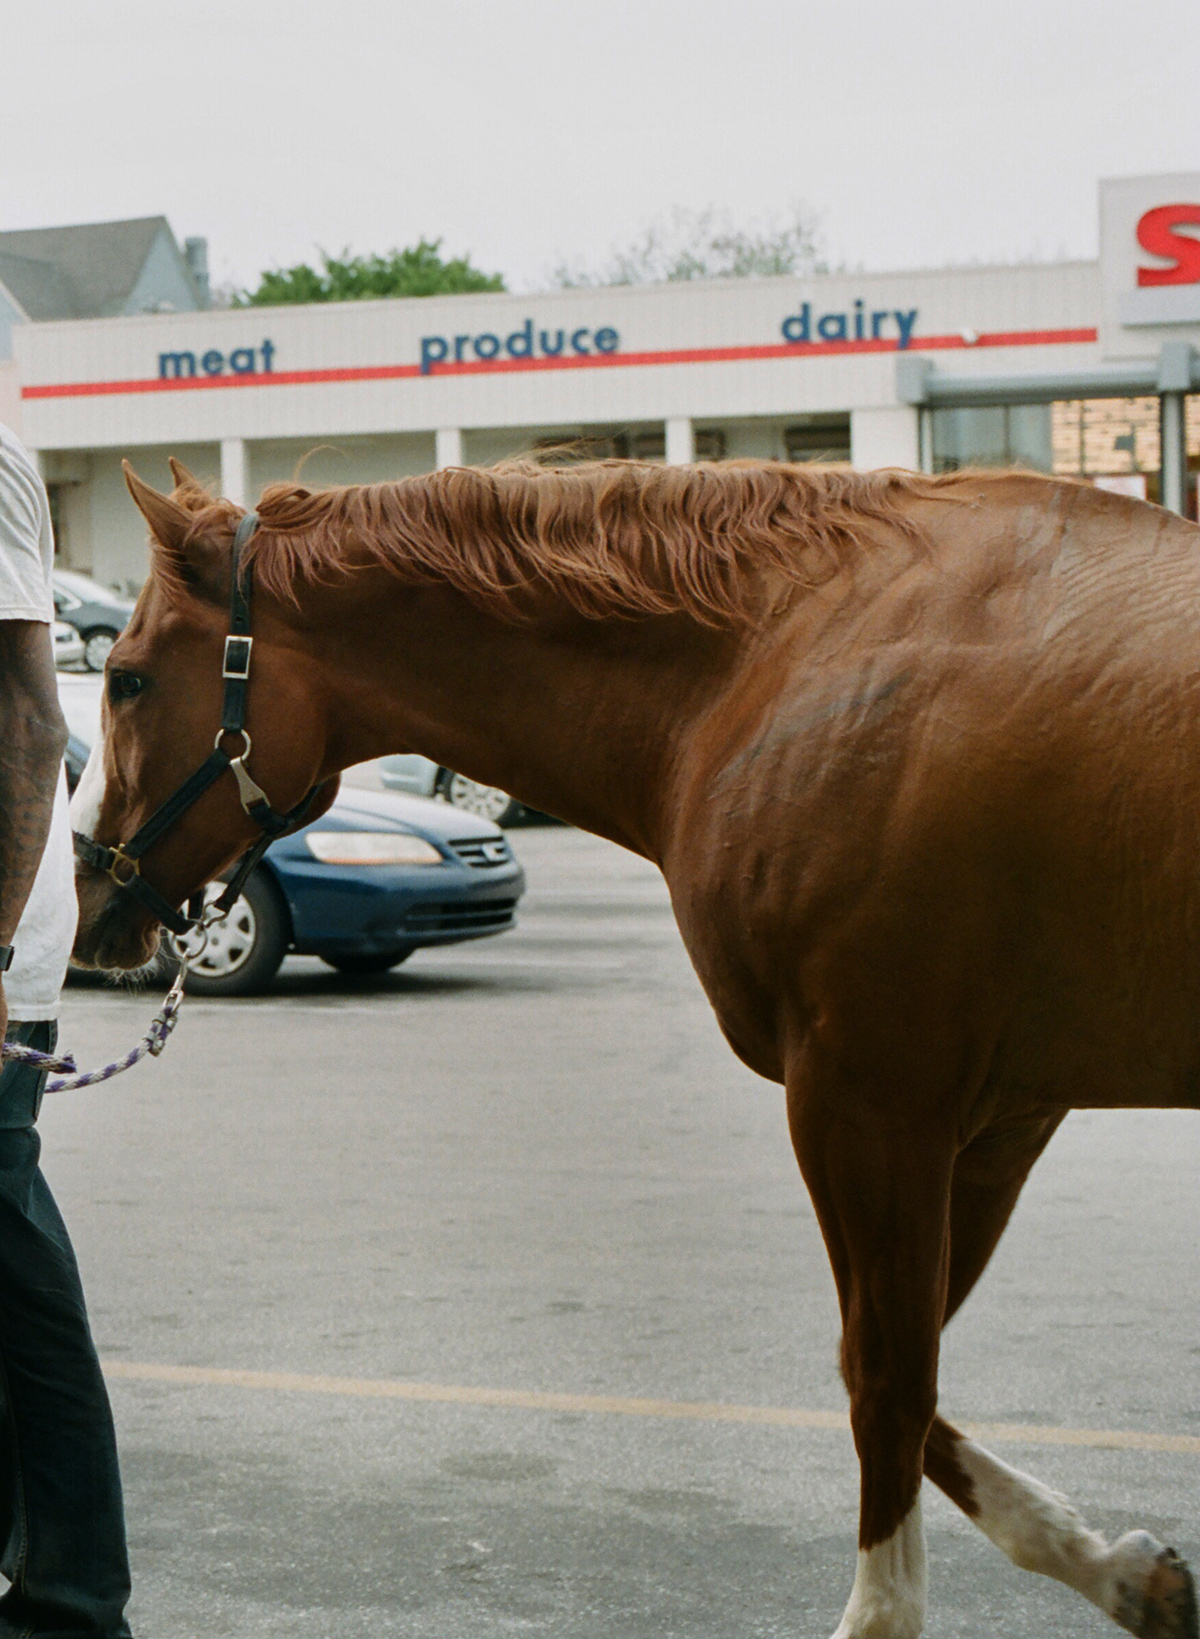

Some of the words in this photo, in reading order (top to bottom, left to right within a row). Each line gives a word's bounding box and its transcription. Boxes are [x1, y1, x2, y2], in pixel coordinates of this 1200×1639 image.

[158, 339, 275, 379] meat
[420, 318, 620, 376] produce
[780, 299, 918, 350] dairy
